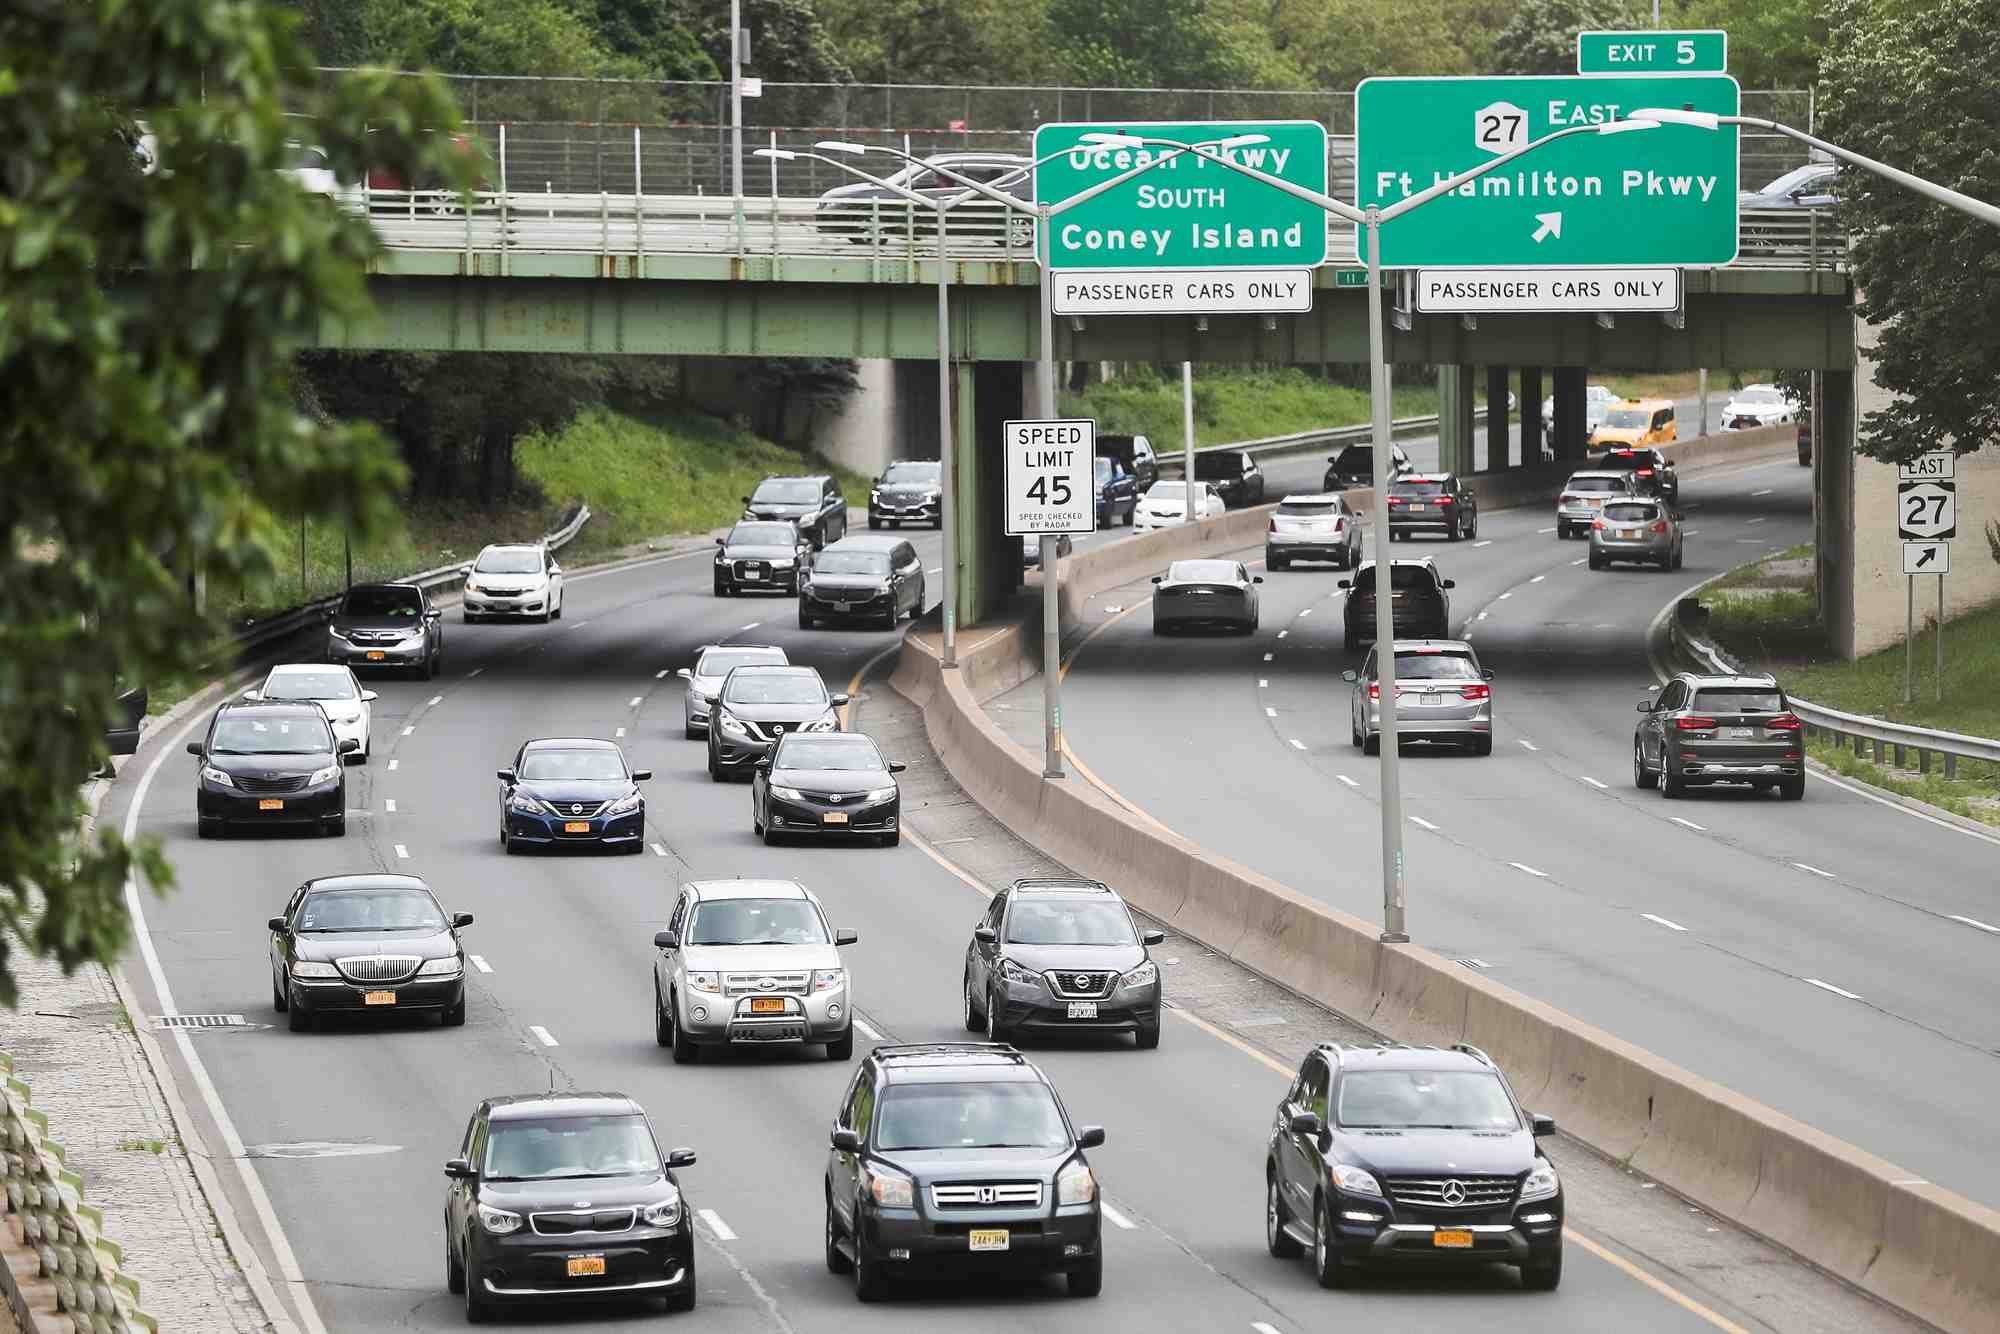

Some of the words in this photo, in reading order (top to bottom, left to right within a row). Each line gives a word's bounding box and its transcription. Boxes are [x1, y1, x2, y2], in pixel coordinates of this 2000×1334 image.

[1608, 44, 1656, 63] EXIT
[1676, 40, 1696, 65] 5
[1548, 100, 1620, 124] EAST
[1482, 115, 1522, 143] 27
[1069, 145, 1177, 171] Ocean
[1137, 185, 1225, 209] SOUTH
[1376, 171, 1413, 197] Ft
[1434, 170, 1603, 197] Hamilton
[1622, 170, 1717, 202] Pkwy
[1062, 223, 1172, 256] Coney
[1192, 222, 1302, 250] Island
[1067, 283, 1174, 301] PASSENGER
[1187, 282, 1235, 299] CARS
[1248, 281, 1297, 299] ONLY
[1430, 282, 1539, 299] PASSENGER
[1551, 281, 1601, 298] CARS
[1614, 280, 1665, 298] ONLY
[1018, 427, 1081, 445] SPEED
[1026, 450, 1074, 468] LIMIT
[1026, 475, 1072, 506] 45
[1019, 512, 1044, 521] SPEED
[1047, 512, 1082, 520] CHECKED
[1906, 495, 1948, 526] 27
[1030, 521, 1041, 529] BY
[1044, 521, 1071, 529] RADAR
